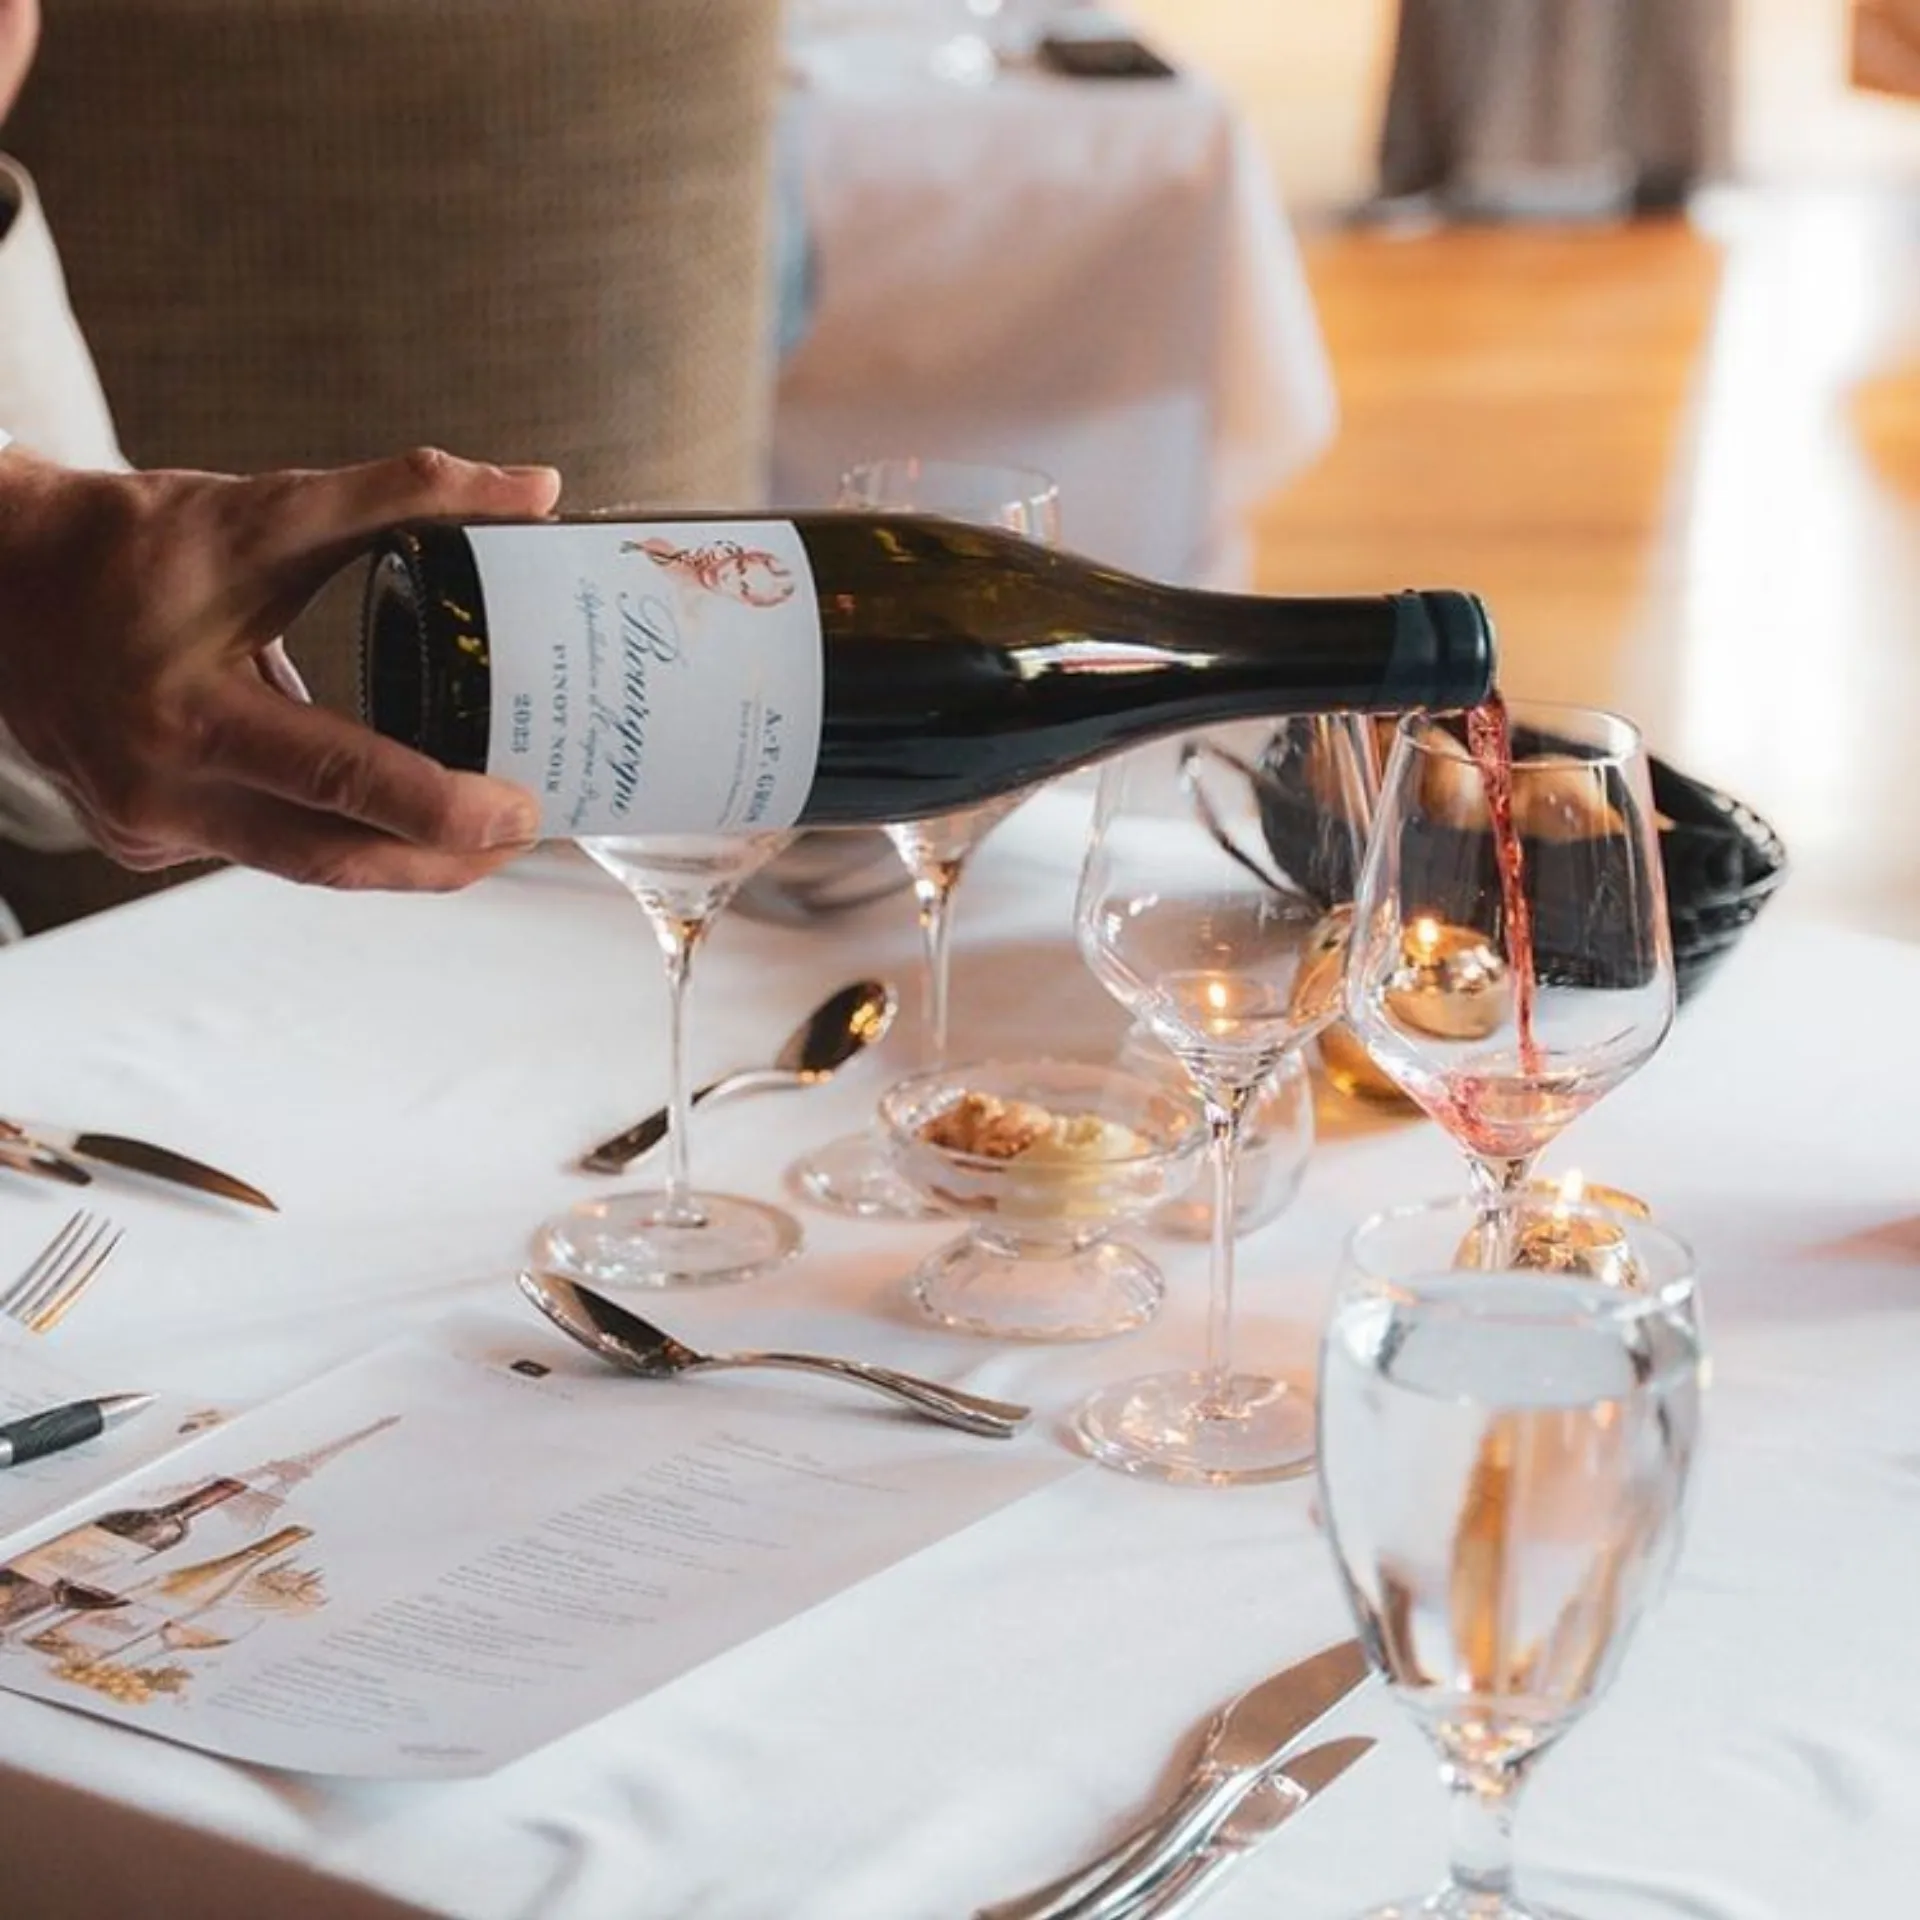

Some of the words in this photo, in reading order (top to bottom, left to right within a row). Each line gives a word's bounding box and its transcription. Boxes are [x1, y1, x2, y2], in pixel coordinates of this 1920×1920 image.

[551, 643, 569, 728] PINOT
[605, 591, 686, 819] Bourgogne
[510, 693, 532, 755] 2023
[545, 732, 567, 794] NOIR
